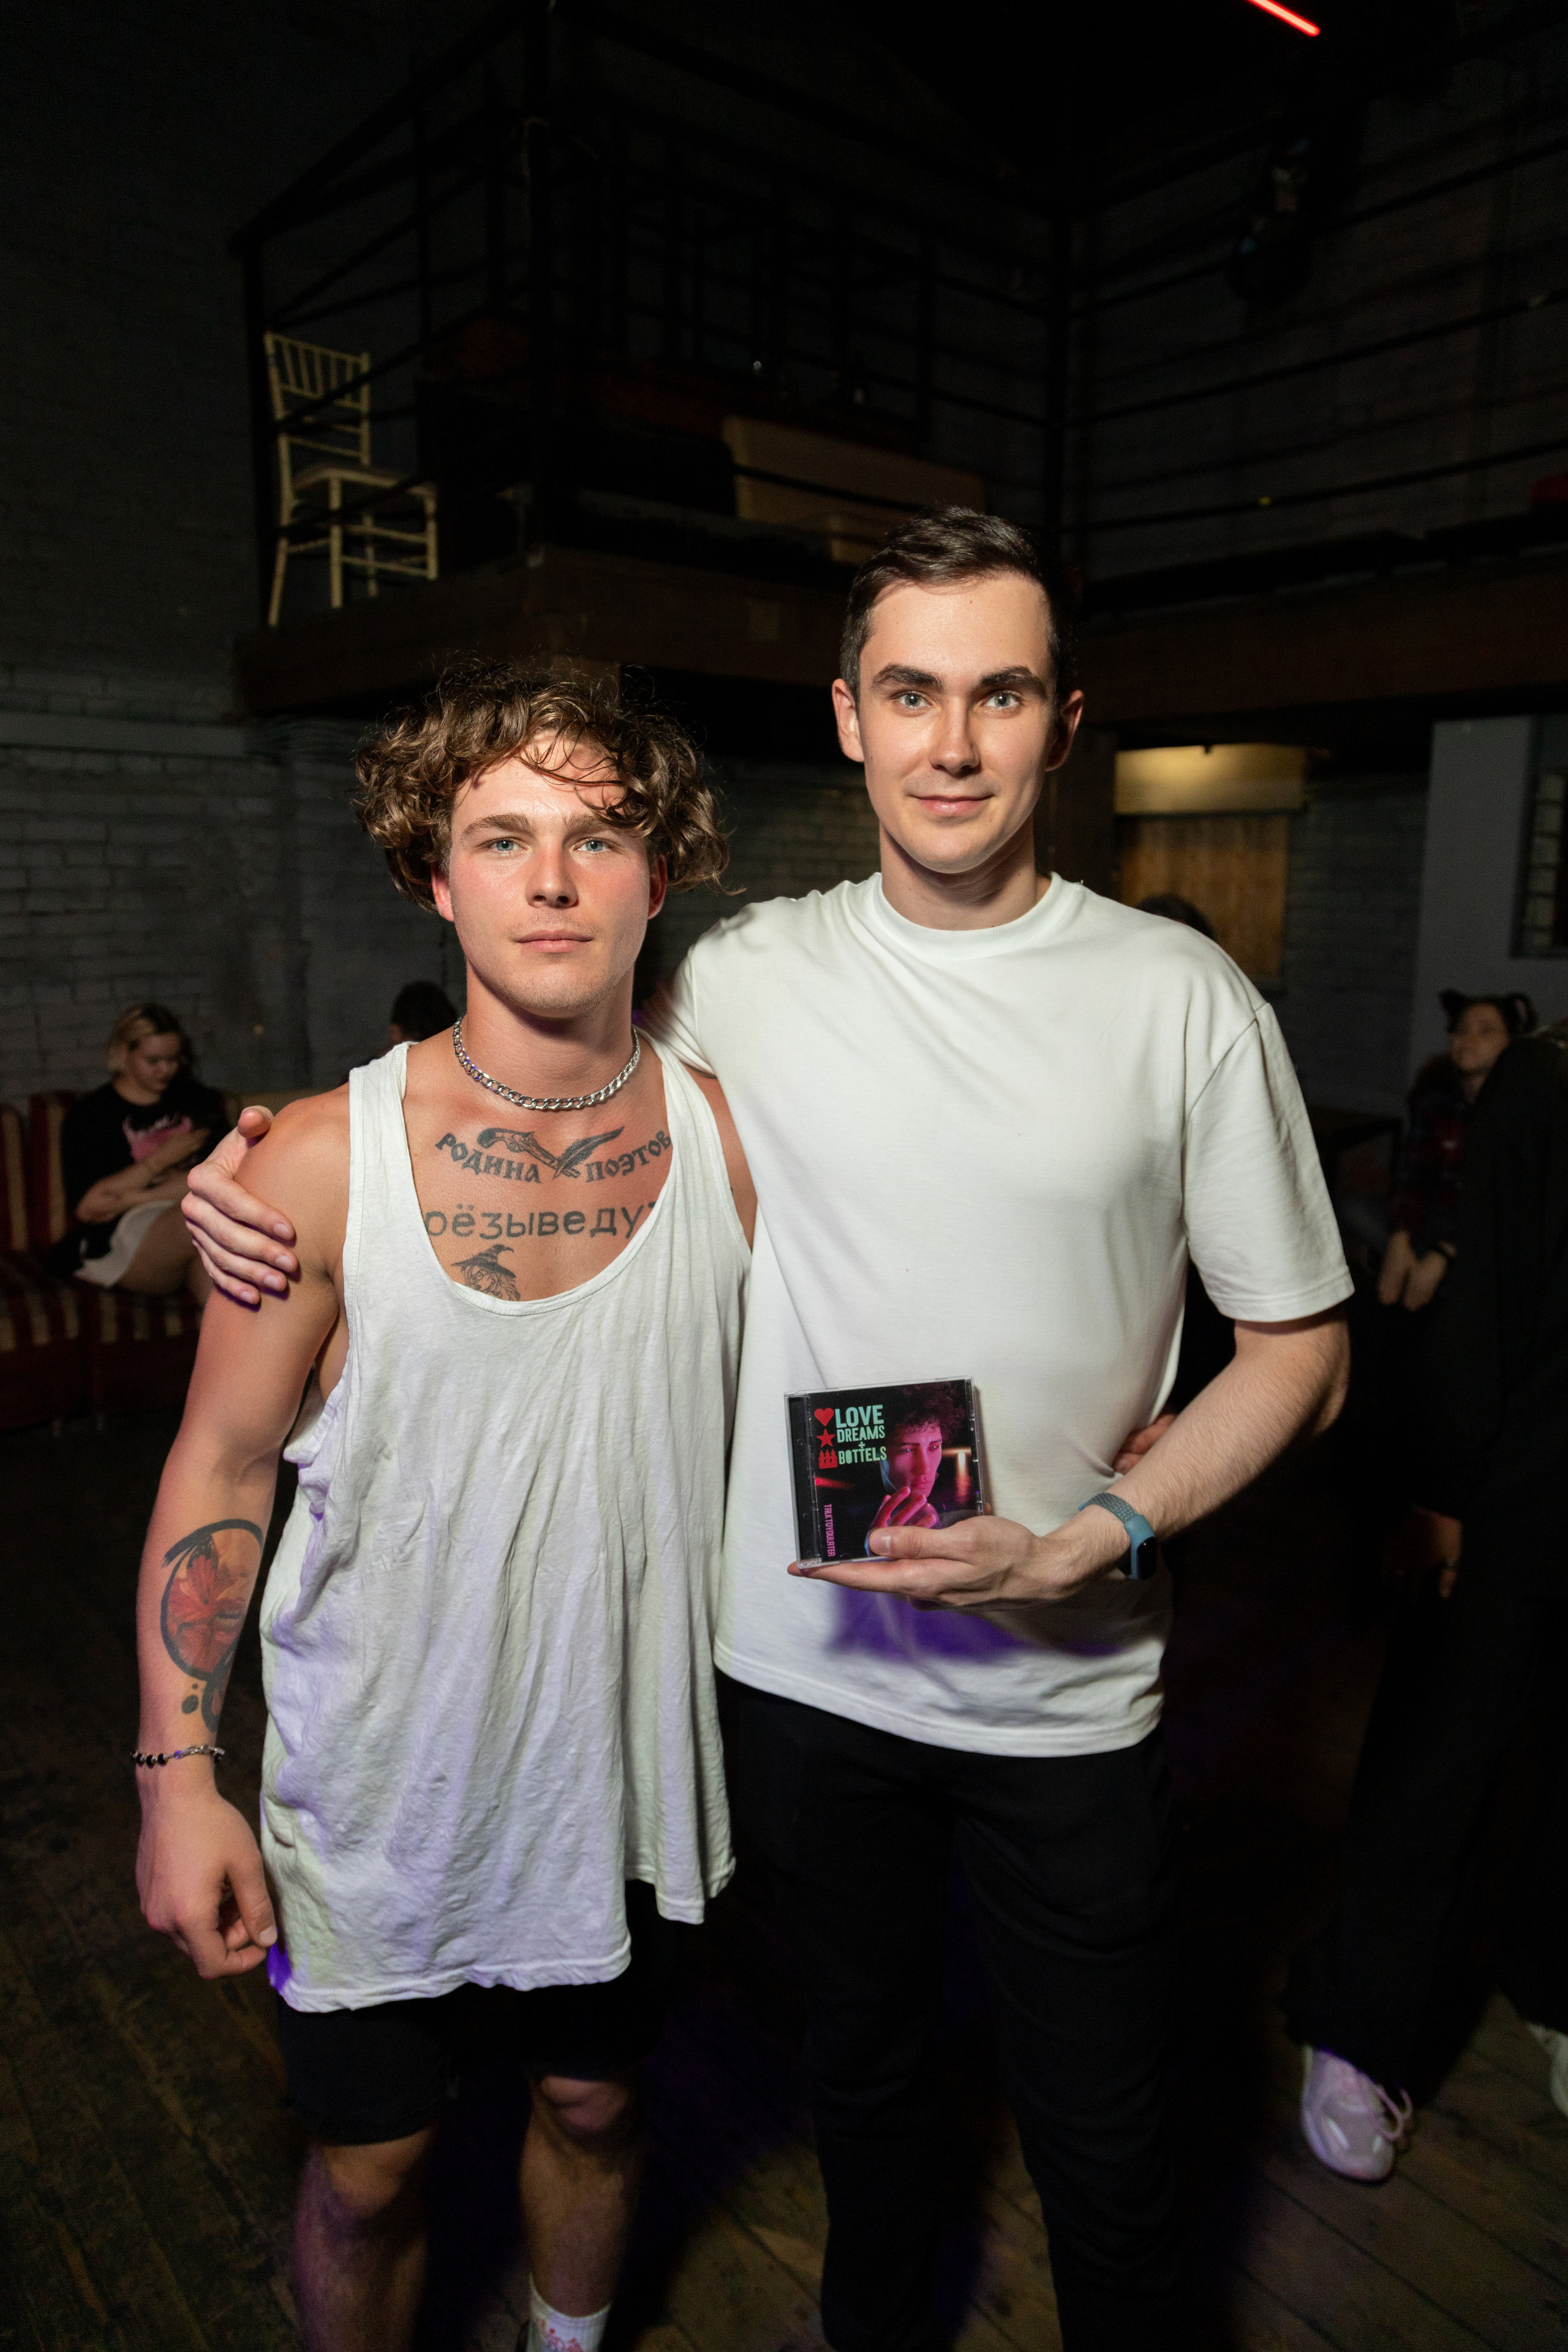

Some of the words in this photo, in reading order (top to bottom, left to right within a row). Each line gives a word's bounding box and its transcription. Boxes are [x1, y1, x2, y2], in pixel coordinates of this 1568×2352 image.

[424, 1203, 657, 1239] оёзыведу
[835, 1404, 884, 1428] LOVE
[837, 1425, 885, 1443] DREAMS
[838, 1446, 887, 1465] BOTTELS
